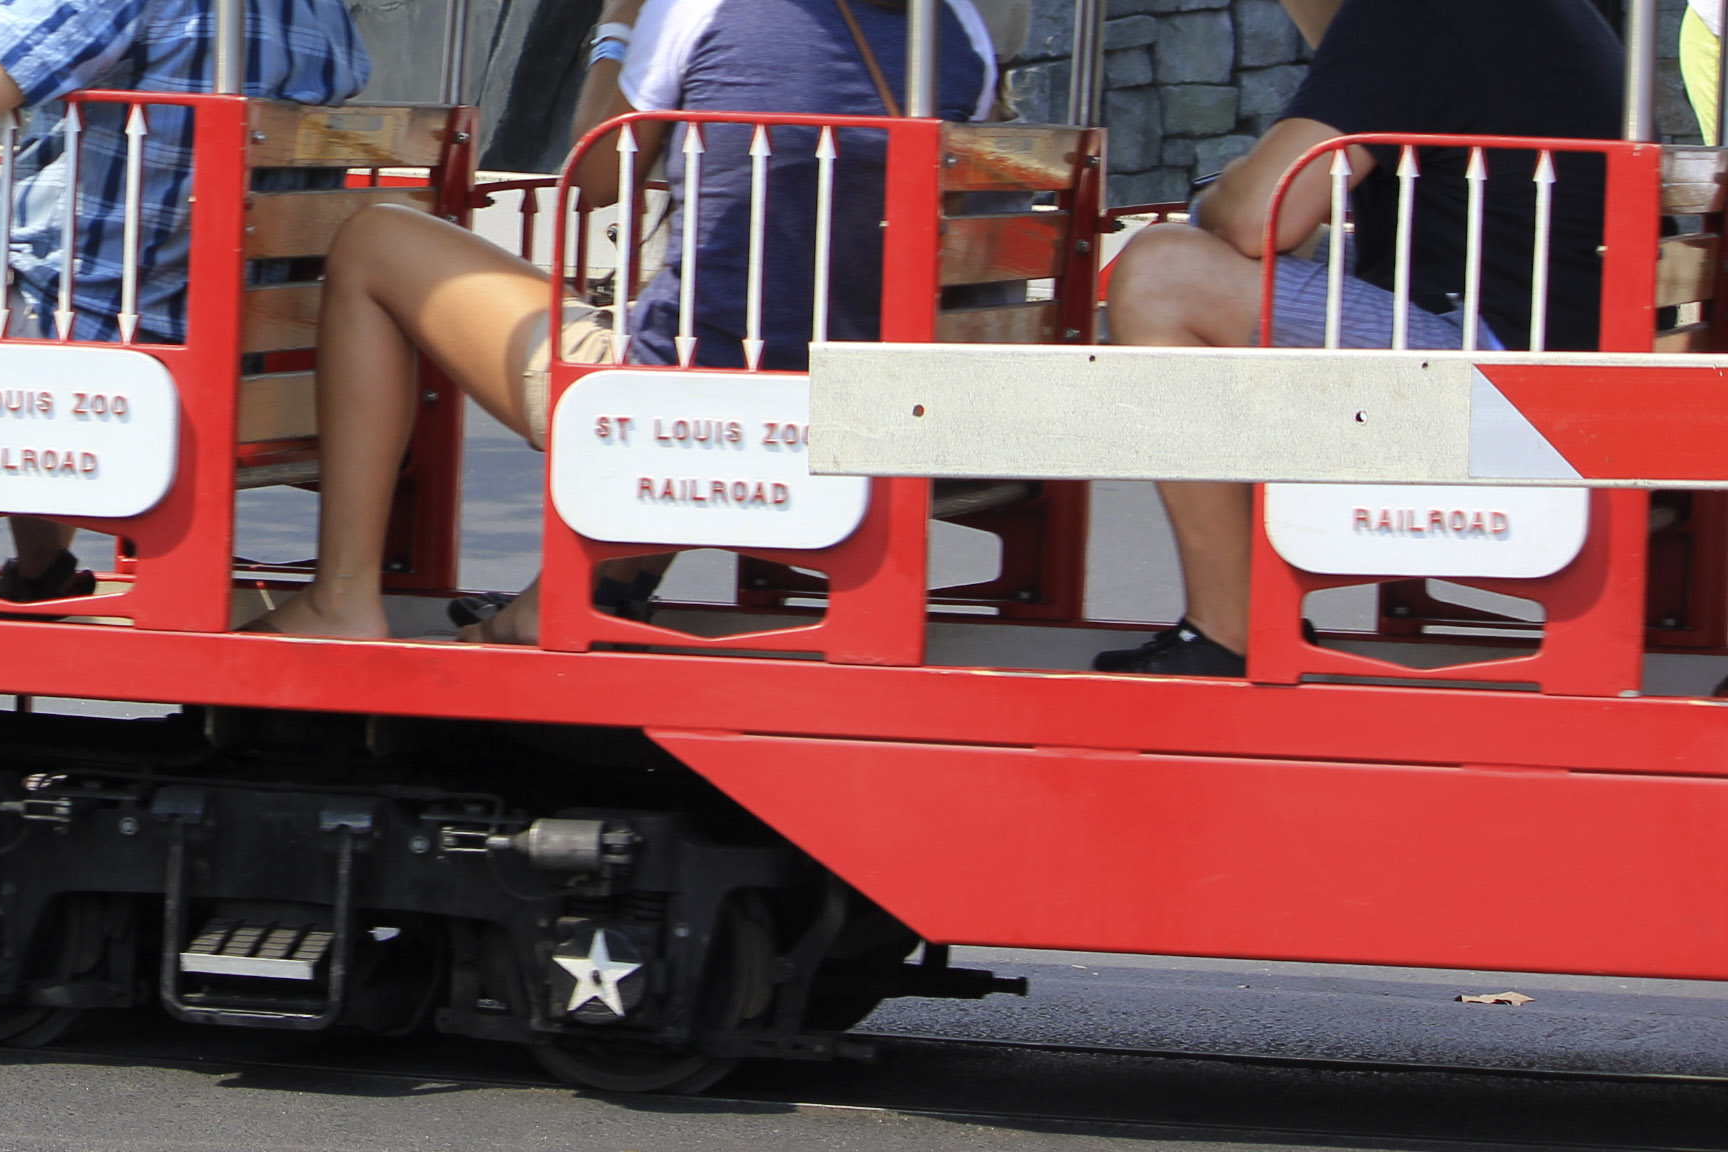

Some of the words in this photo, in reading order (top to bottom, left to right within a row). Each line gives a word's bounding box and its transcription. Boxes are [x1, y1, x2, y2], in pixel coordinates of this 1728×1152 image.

[70, 391, 130, 419] ZOO
[594, 415, 634, 441] ST
[653, 418, 744, 445] LOUIS
[637, 476, 790, 508] RAILROAD
[1353, 506, 1510, 535] RAILROAD
